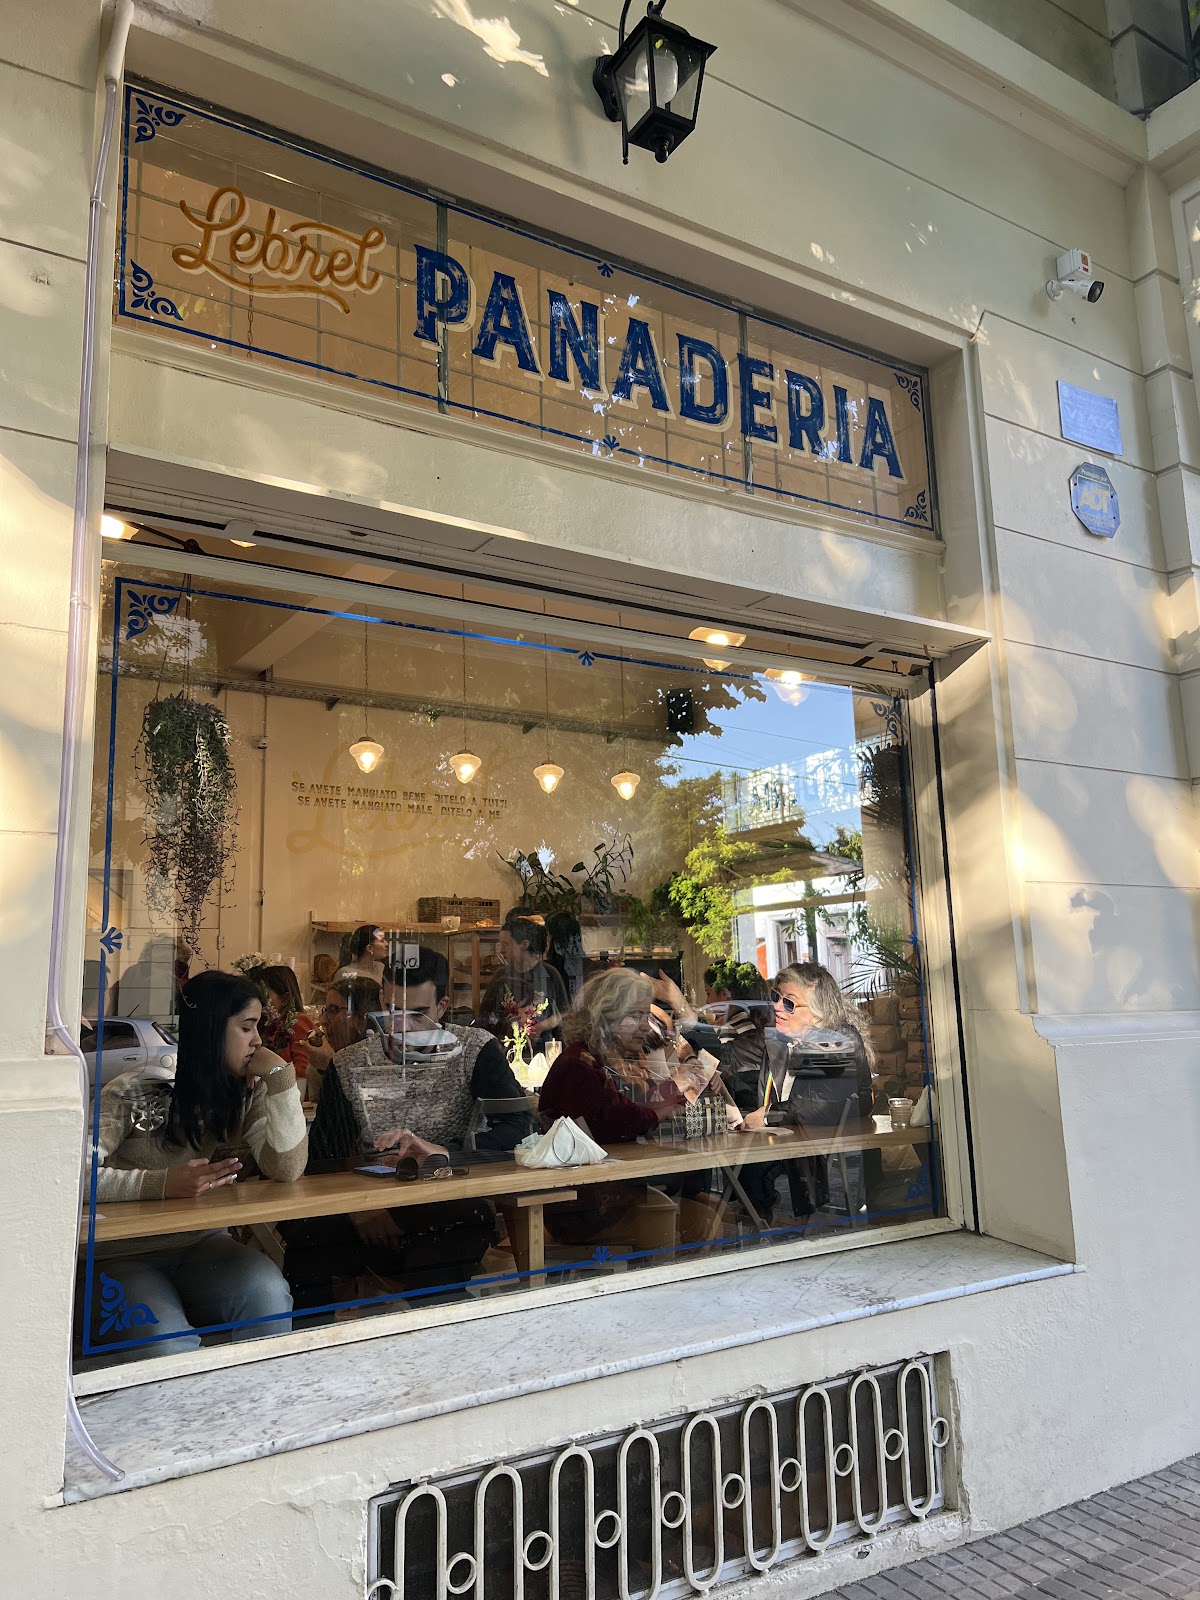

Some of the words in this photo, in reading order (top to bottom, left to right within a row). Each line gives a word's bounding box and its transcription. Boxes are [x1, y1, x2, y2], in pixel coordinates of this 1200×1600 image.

[414, 244, 907, 481] PANADERIA
[1078, 485, 1110, 514] ADT
[291, 781, 305, 793] SE
[309, 784, 342, 796] AVETE
[347, 786, 398, 800] MANGIATO
[435, 794, 466, 806] DITELO
[471, 797, 477, 806] A
[297, 796, 311, 807] SE
[314, 797, 347, 809] AVETE
[352, 799, 402, 813] MANGIATO
[441, 806, 473, 818] DITELO
[477, 809, 484, 818] A
